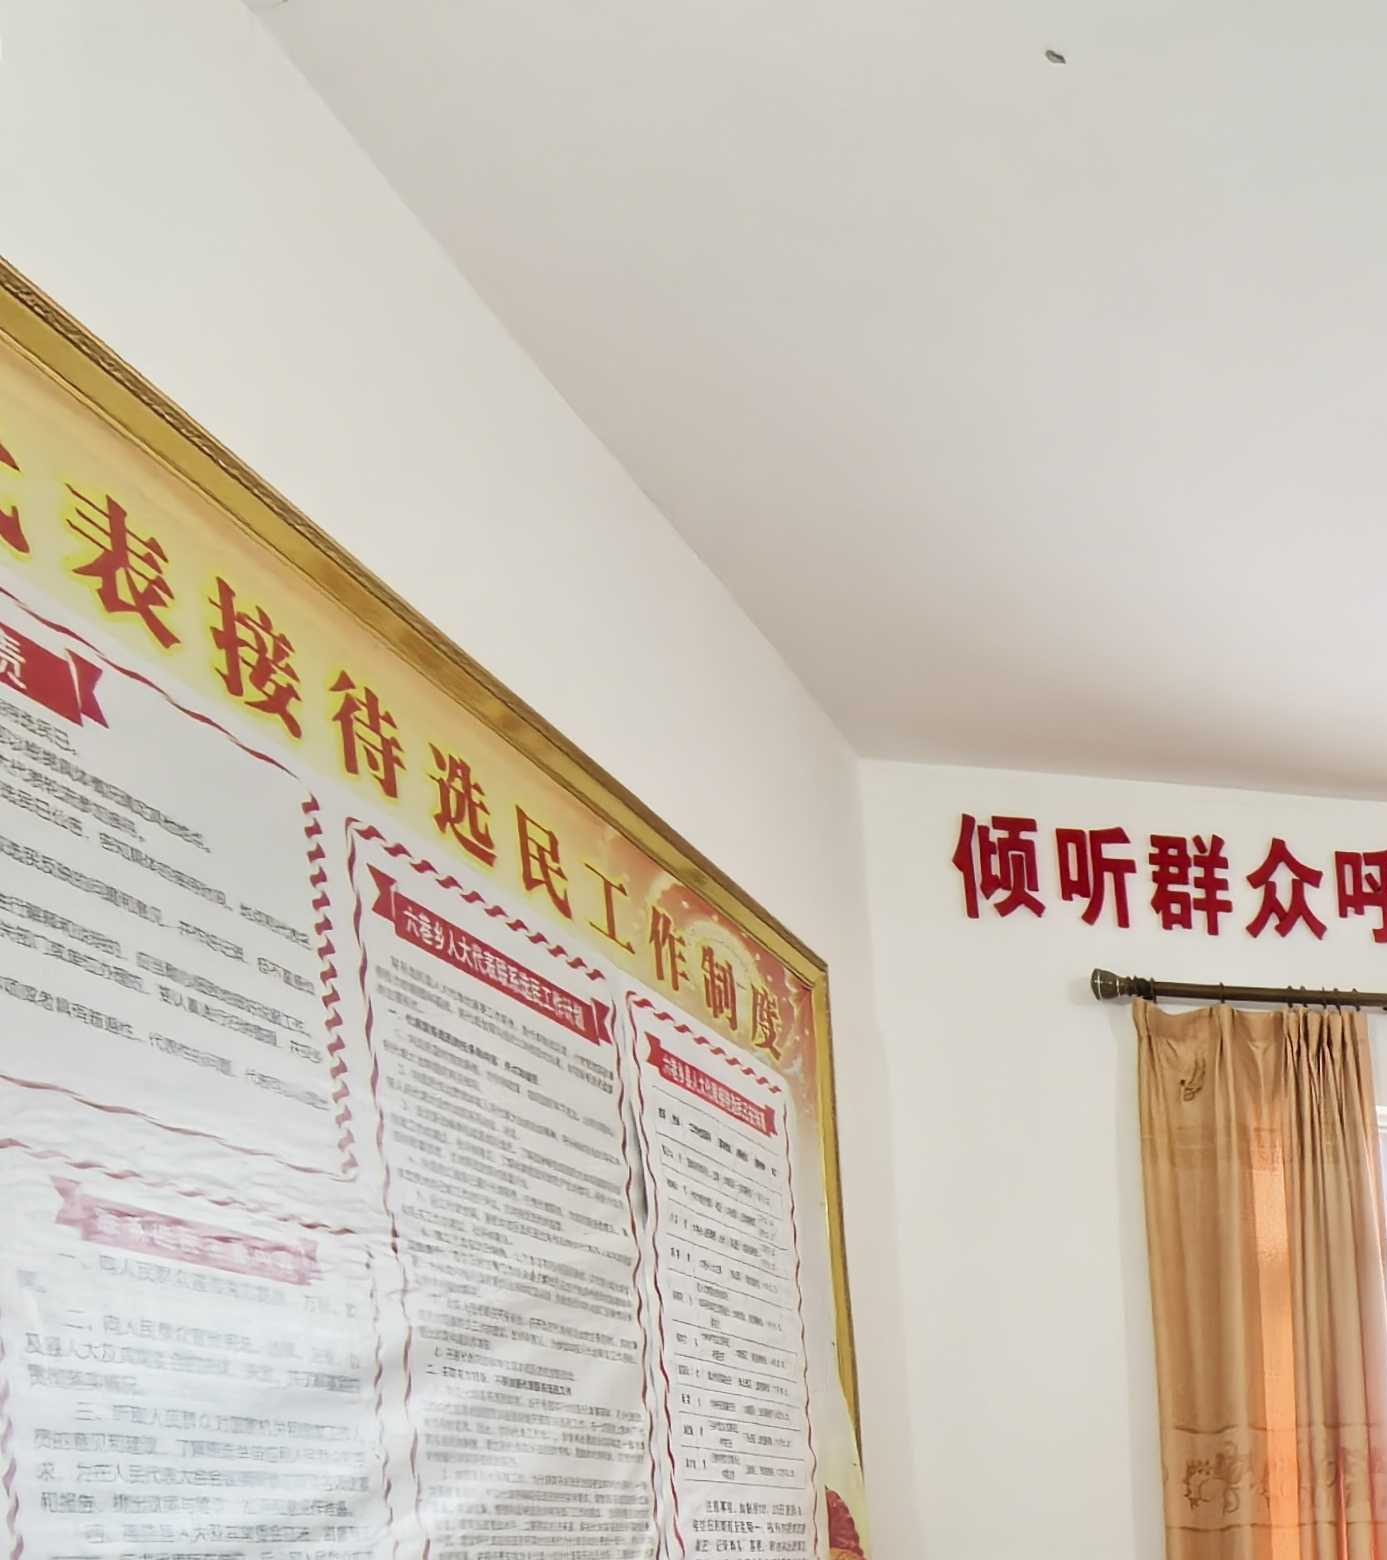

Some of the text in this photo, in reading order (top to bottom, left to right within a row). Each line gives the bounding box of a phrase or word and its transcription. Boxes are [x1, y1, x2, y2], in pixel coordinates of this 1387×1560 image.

[0, 440, 781, 1060] 表接待选民工作制度
